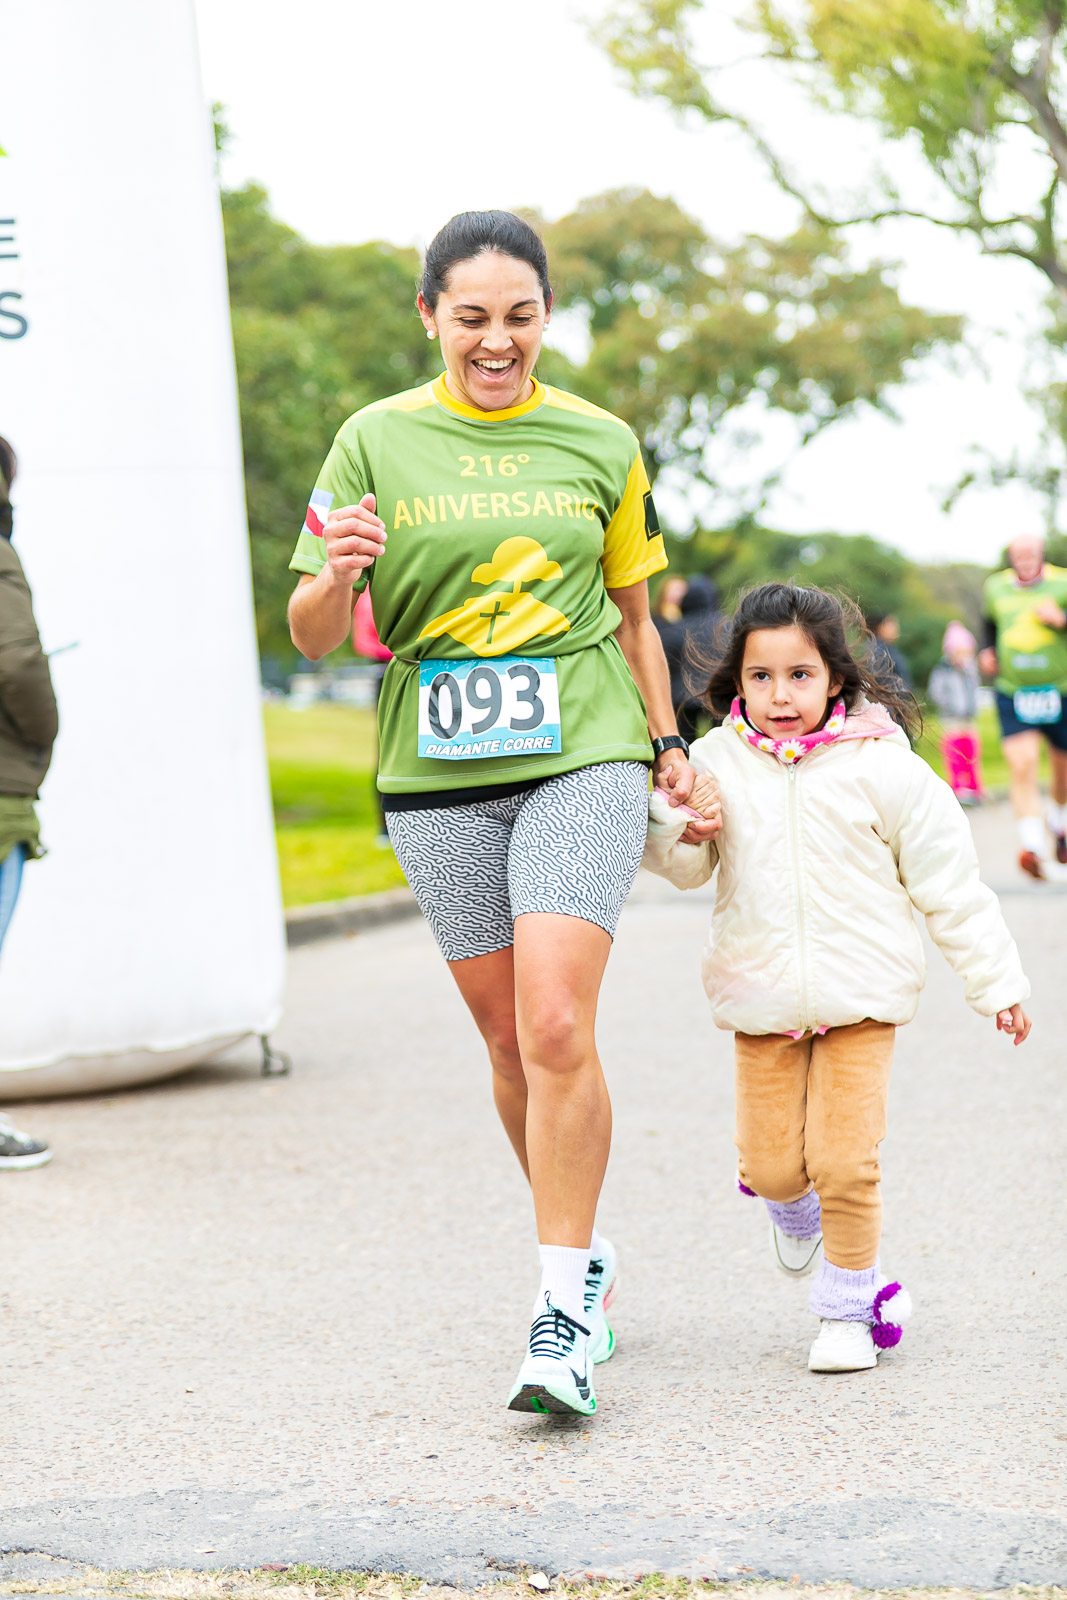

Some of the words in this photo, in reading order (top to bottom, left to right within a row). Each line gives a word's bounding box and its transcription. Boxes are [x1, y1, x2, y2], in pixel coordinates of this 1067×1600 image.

[393, 491, 598, 530] ANIVERSARIO
[428, 664, 545, 740] 093
[425, 740, 501, 756] DIAMANTE
[503, 736, 554, 751] CORRE
